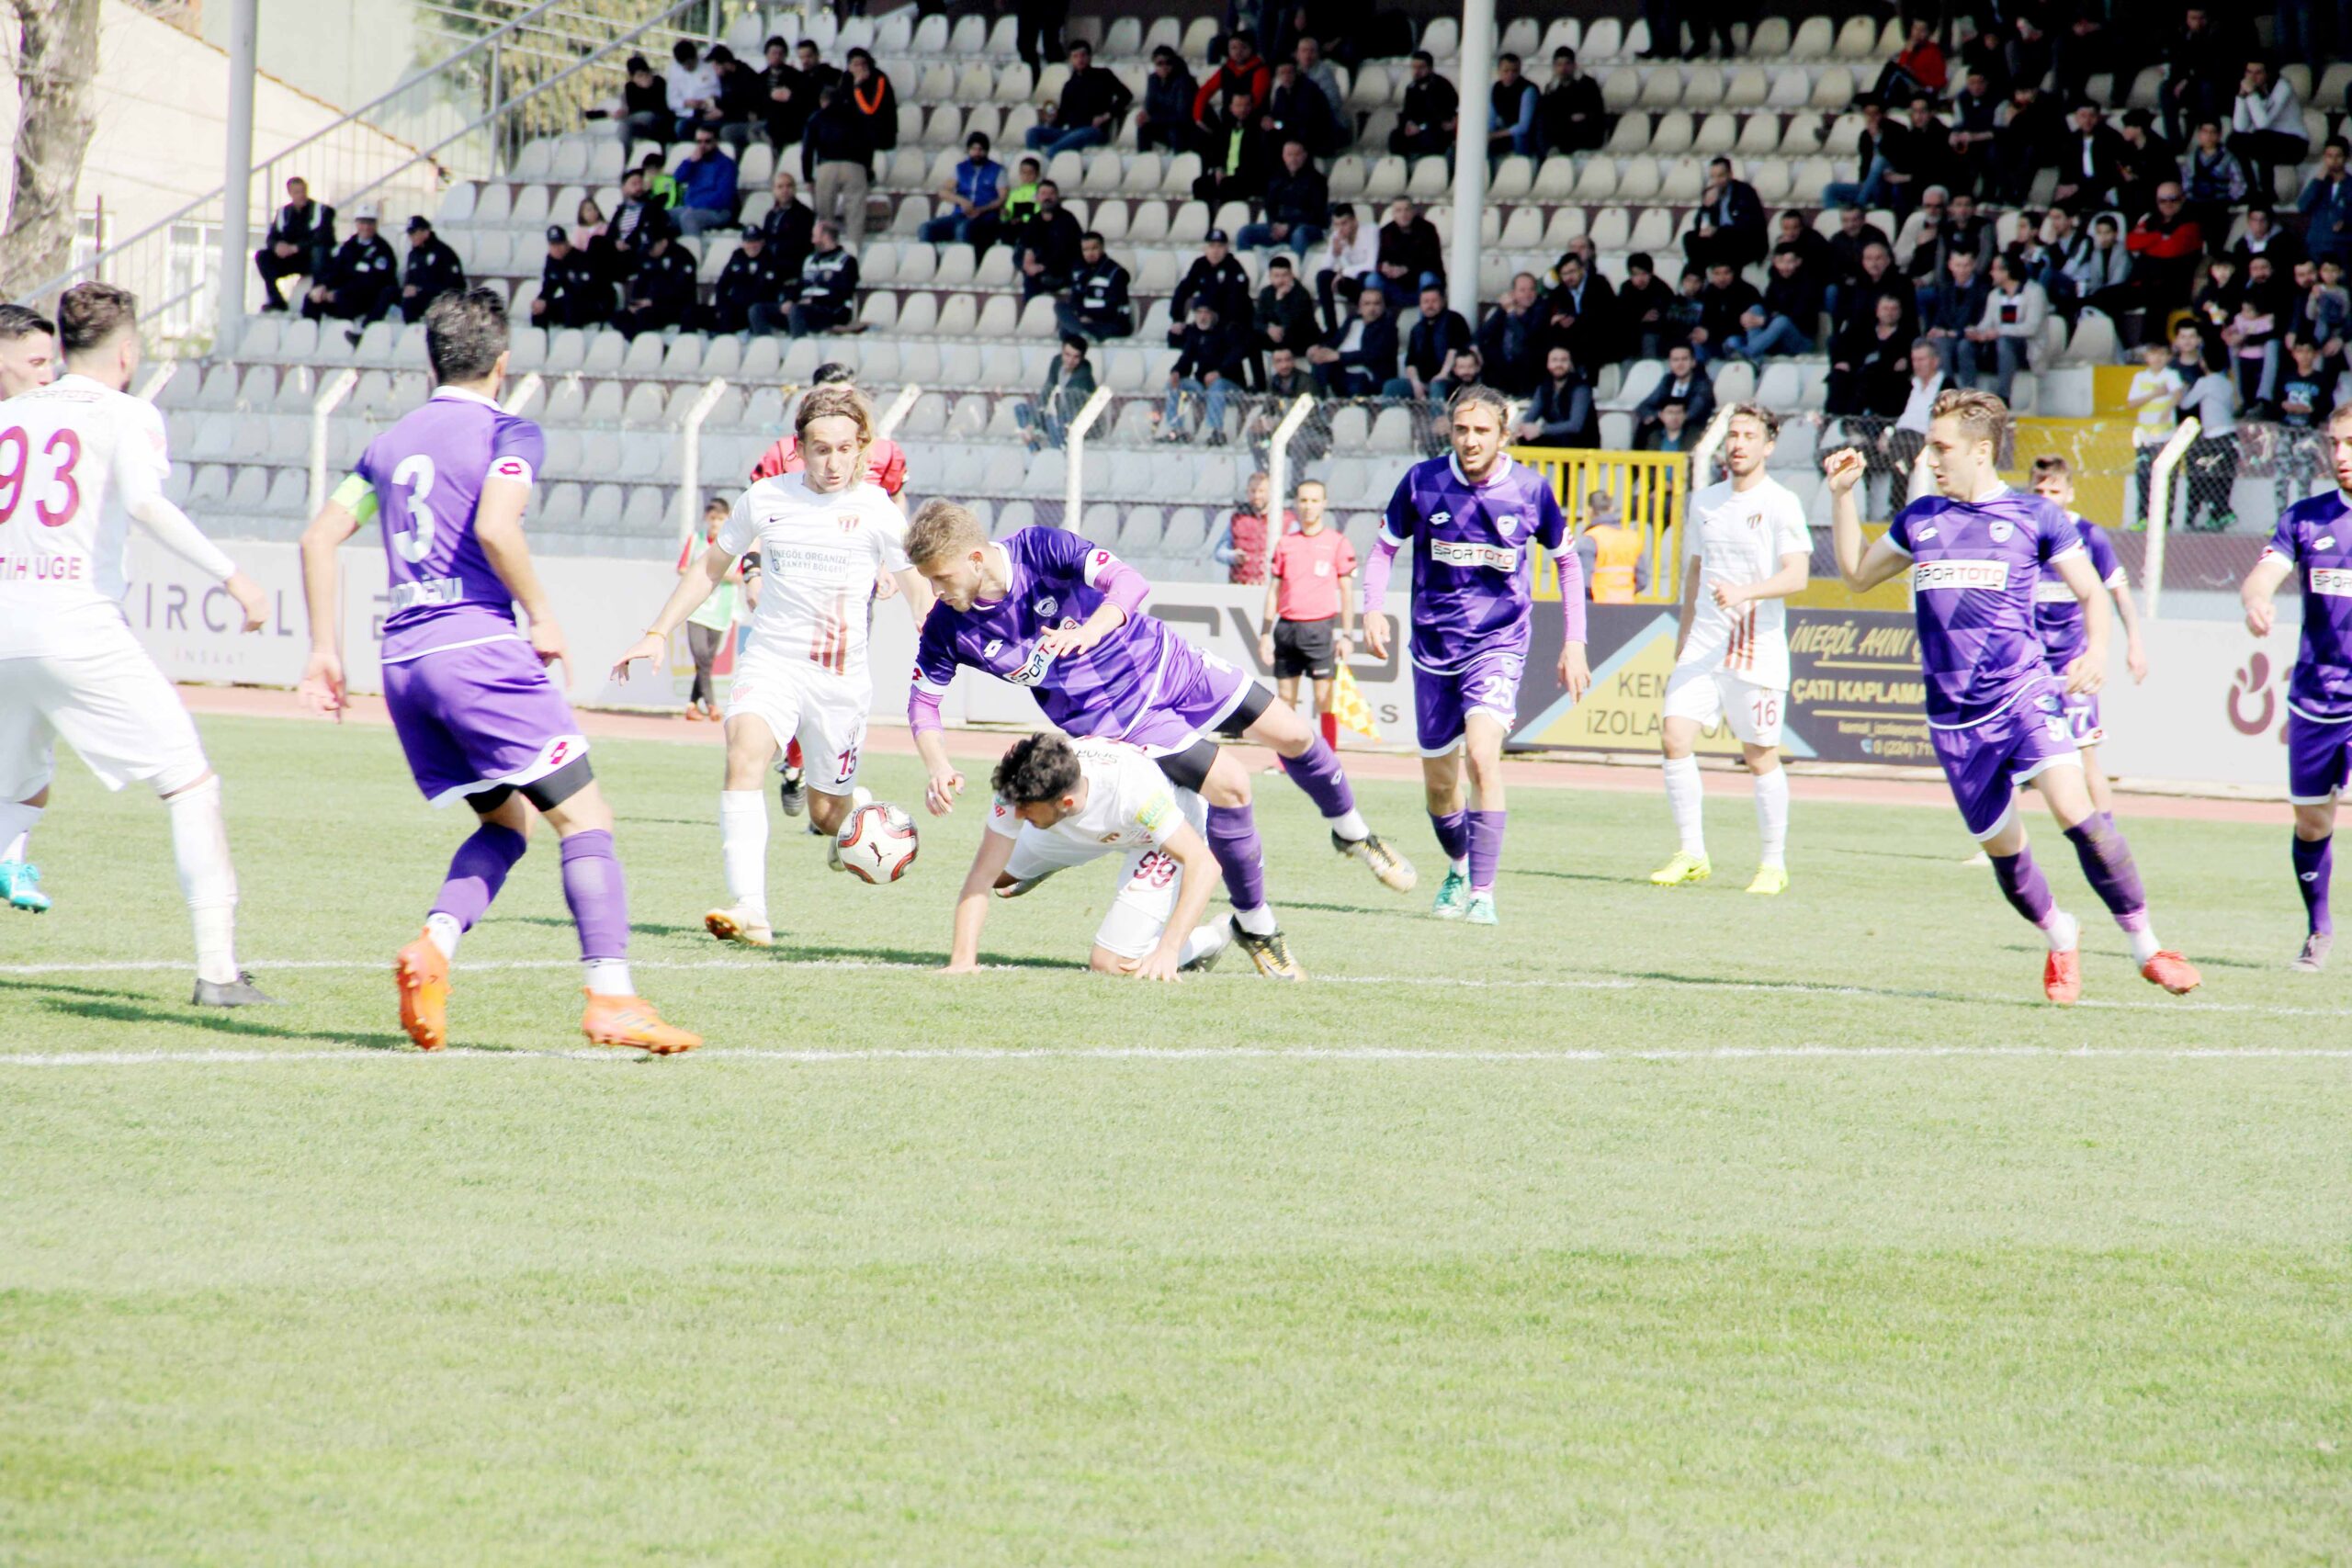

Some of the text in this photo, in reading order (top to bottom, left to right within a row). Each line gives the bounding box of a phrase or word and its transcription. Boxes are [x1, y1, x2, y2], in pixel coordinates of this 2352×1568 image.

[0, 426, 81, 526] 93
[391, 454, 435, 563] 3
[1483, 675, 1514, 708] 25
[1792, 678, 1836, 705] ÇATI
[1752, 700, 1777, 727] 16
[837, 747, 857, 775] 15
[1134, 850, 1177, 888] 99
